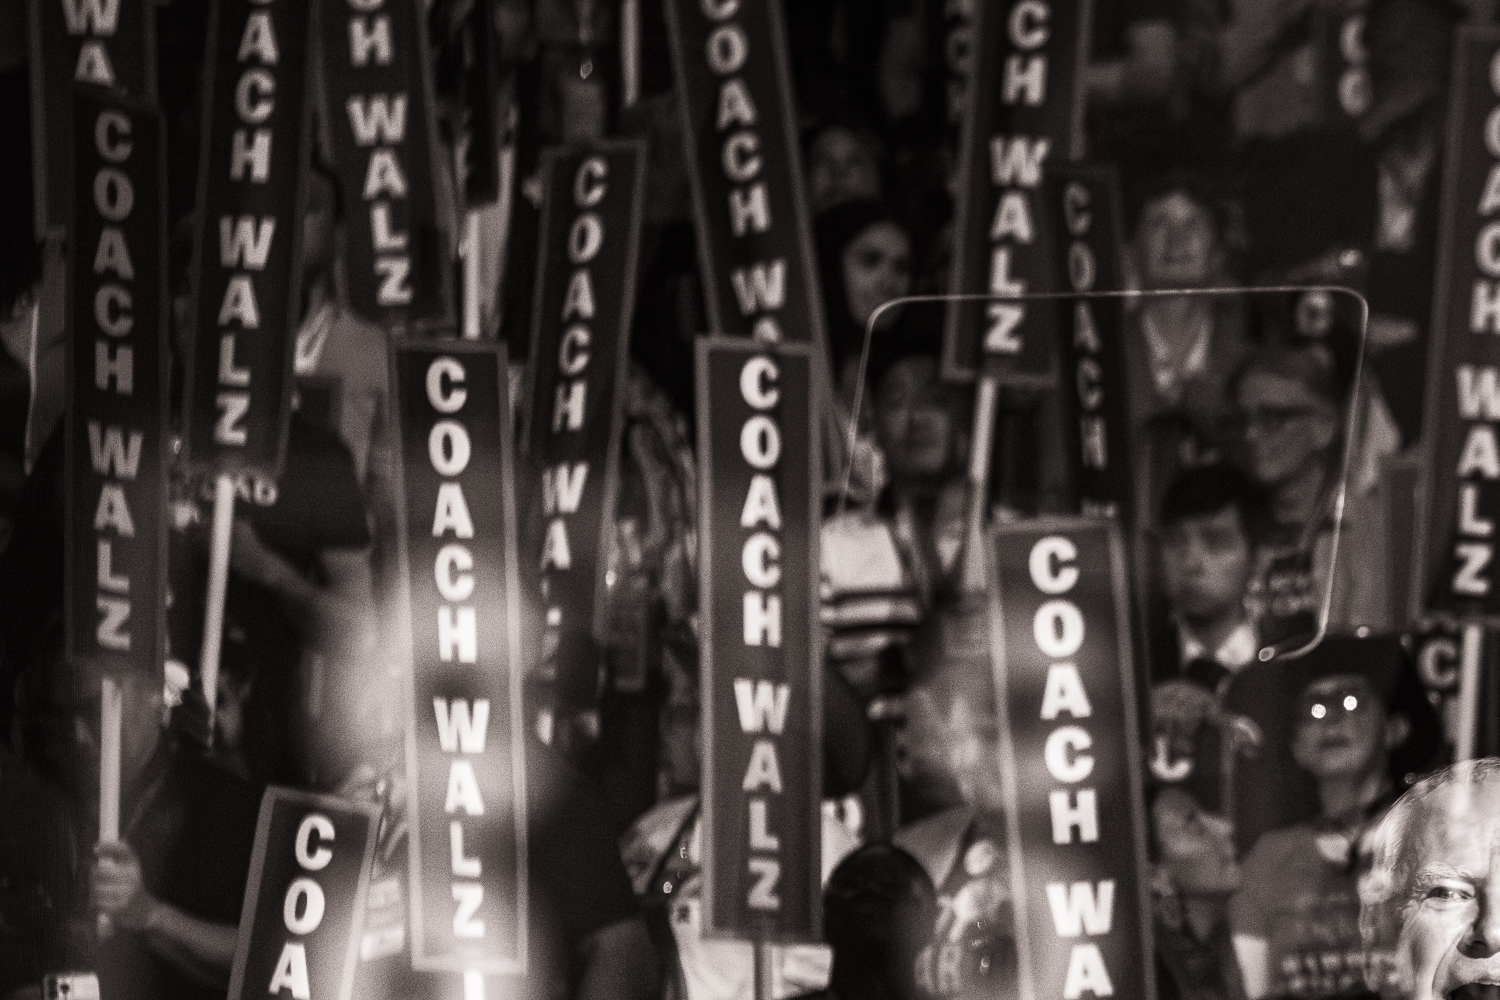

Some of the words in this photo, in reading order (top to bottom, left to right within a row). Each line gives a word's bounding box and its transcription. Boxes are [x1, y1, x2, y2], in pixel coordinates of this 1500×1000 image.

[229, 0, 282, 184] ACH
[346, 93, 414, 305] WALZ
[705, 0, 772, 237] OACH
[93, 110, 135, 395] COACH
[213, 215, 278, 446] WALZ
[551, 156, 609, 433] COACH
[984, 135, 1051, 356] WALZ
[88, 419, 144, 651] WALZ
[425, 355, 478, 664] COACH
[738, 355, 782, 648] COACH
[733, 678, 791, 912] WALZ
[1029, 535, 1102, 845] COACH
[431, 698, 490, 939] WALZ
